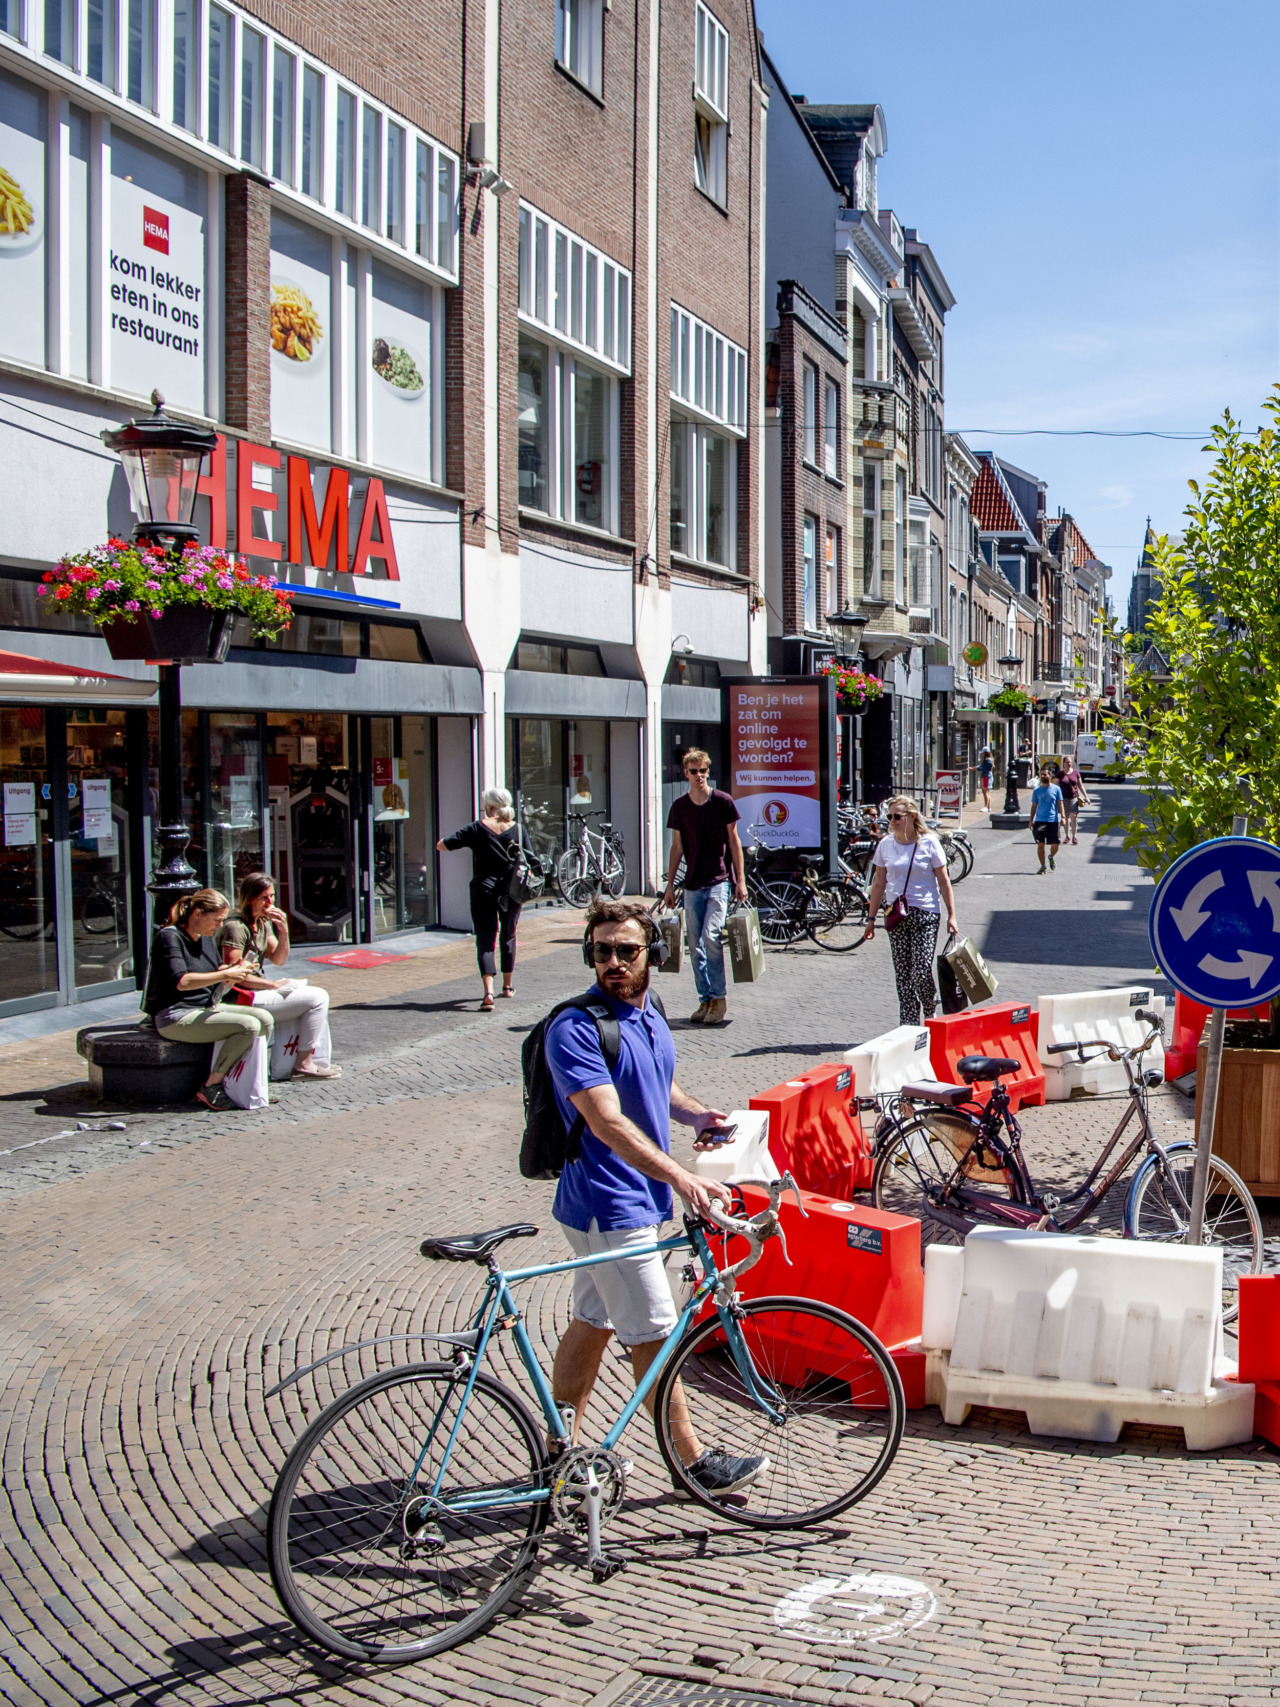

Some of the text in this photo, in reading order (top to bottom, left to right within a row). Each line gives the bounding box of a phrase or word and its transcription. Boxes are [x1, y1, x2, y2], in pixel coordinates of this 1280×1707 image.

[144, 221, 168, 240] HEMA
[110, 249, 201, 302] kom lekker
[111, 284, 199, 330] eten in ons
[111, 312, 198, 357] restaurant
[168, 432, 400, 581] HEMA
[738, 694, 804, 708] Ben je het
[738, 709, 782, 720] zat om
[738, 723, 778, 734] online
[738, 737, 807, 751] gevolgd te
[738, 752, 794, 763] worden?
[739, 774, 812, 784] Wij kunnen helpen.
[753, 829, 800, 838] DuckDuckGo
[847, 1234, 882, 1247] agterberg b.v.
